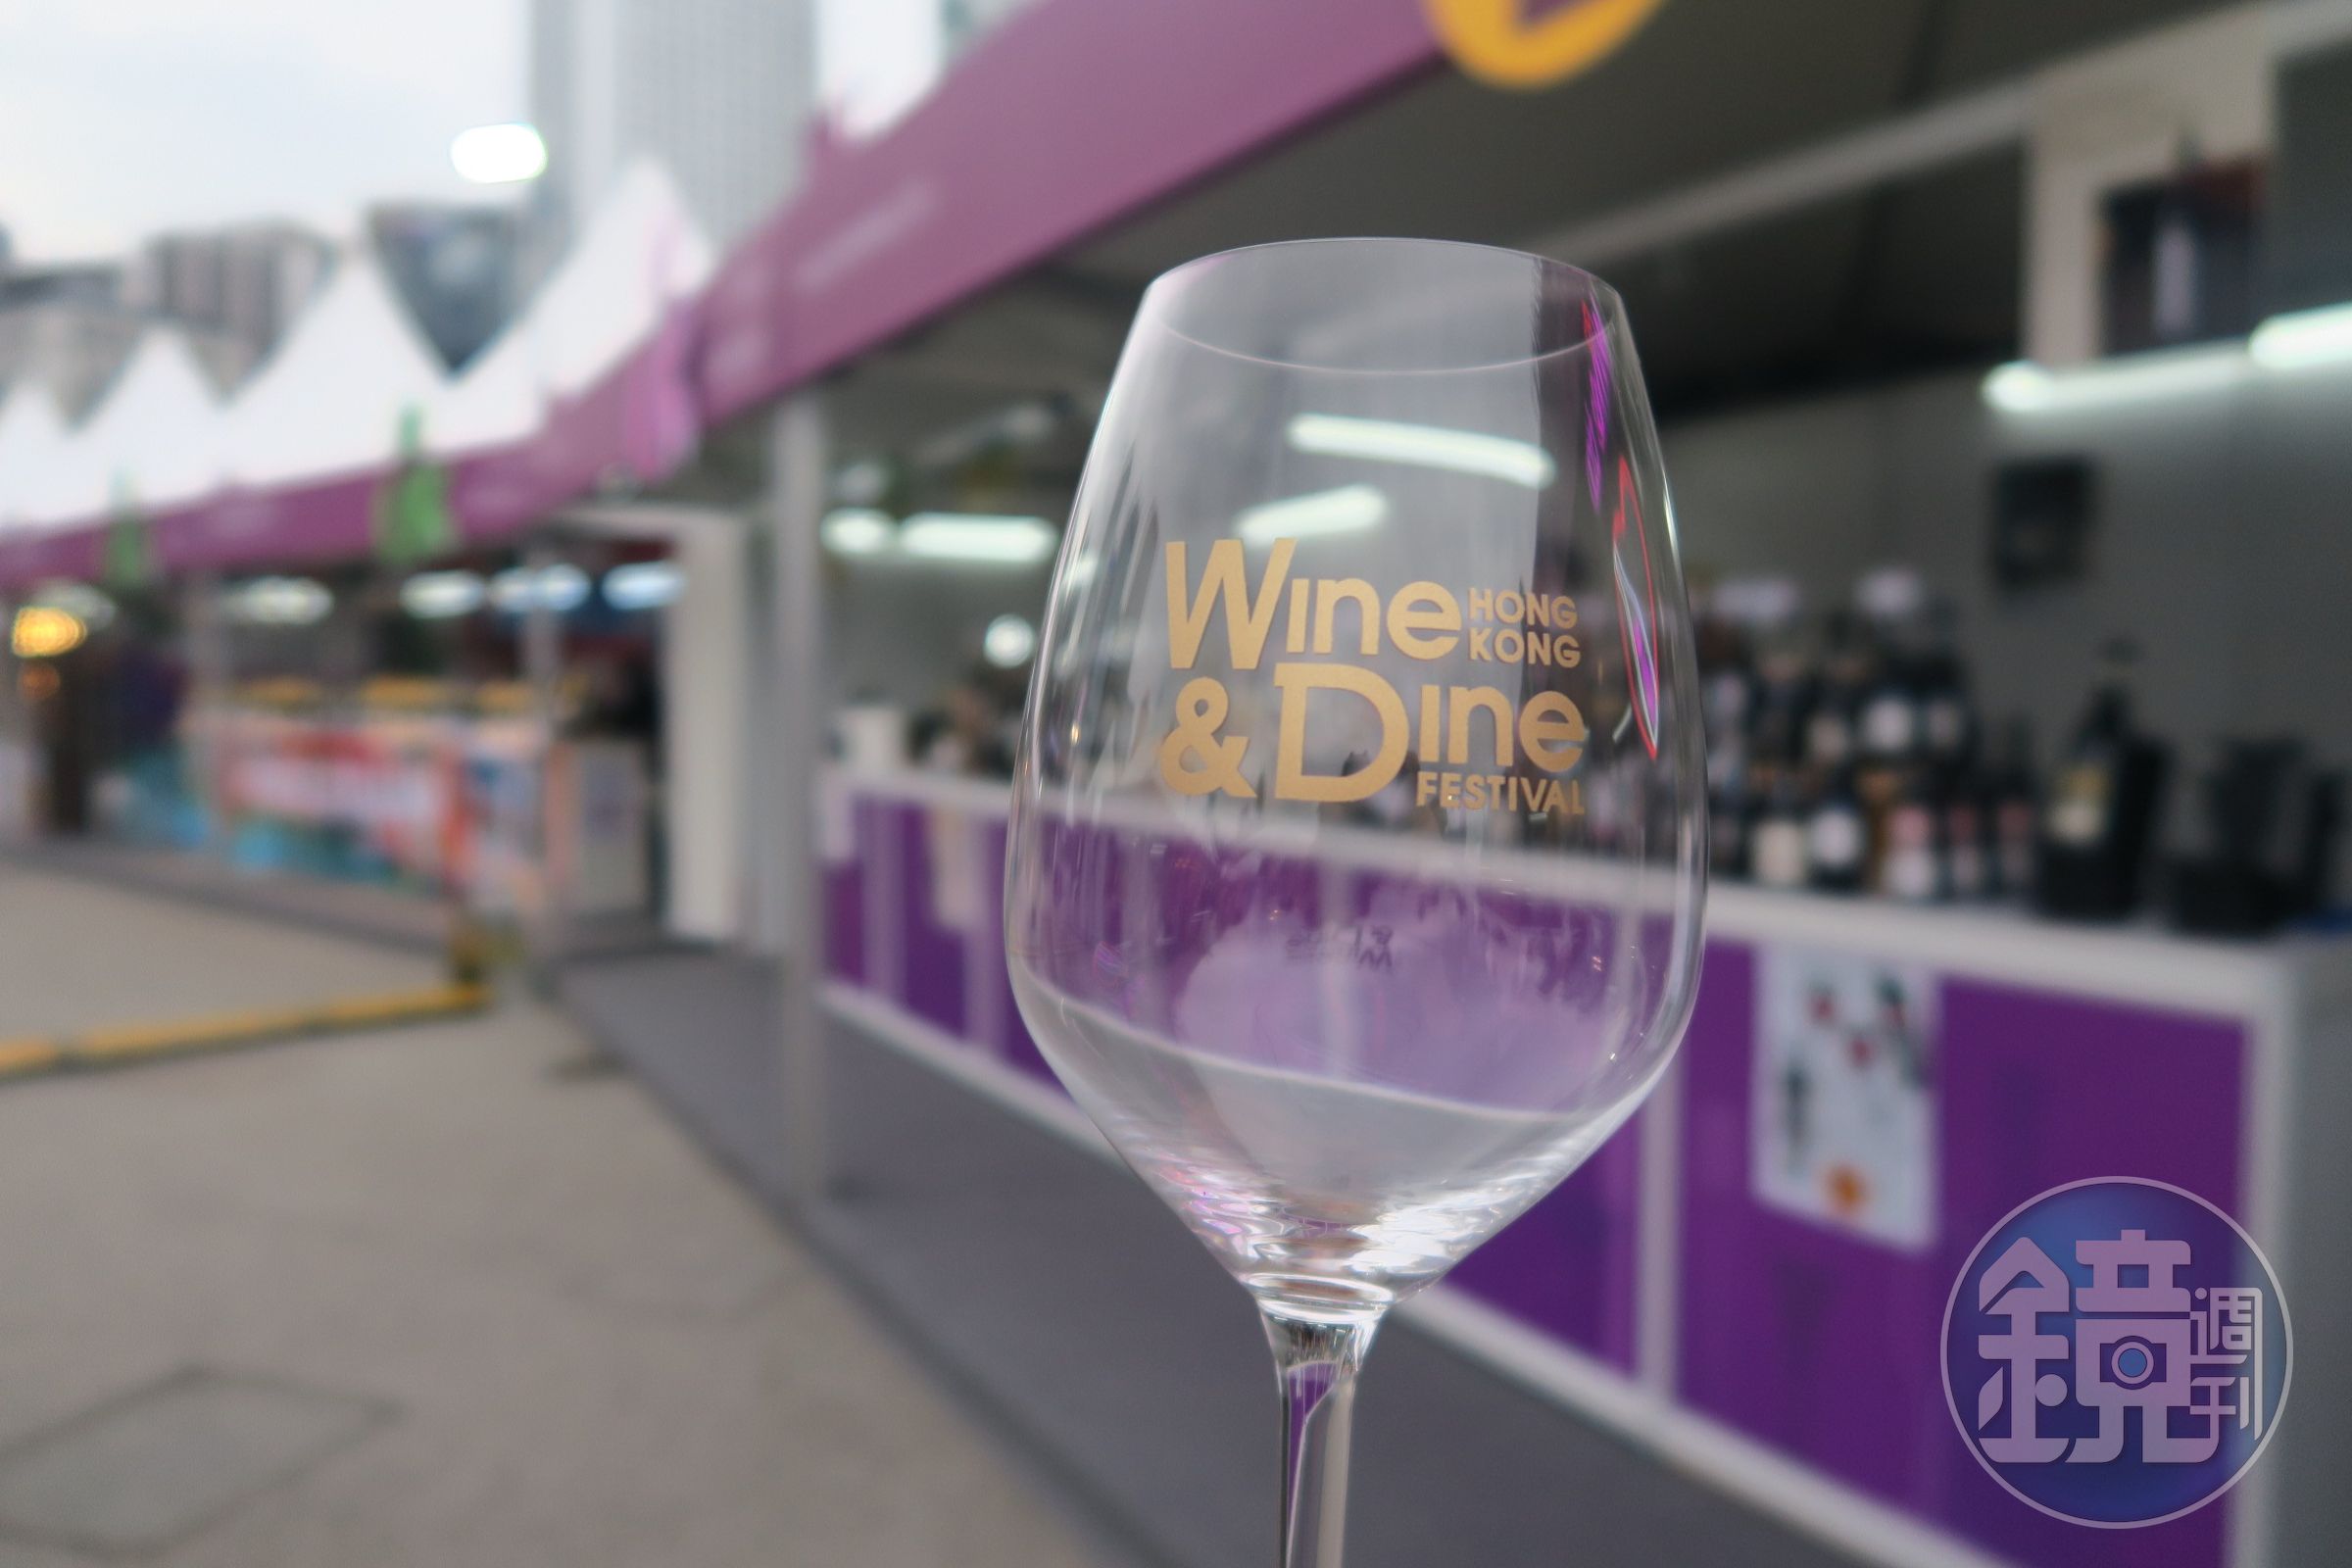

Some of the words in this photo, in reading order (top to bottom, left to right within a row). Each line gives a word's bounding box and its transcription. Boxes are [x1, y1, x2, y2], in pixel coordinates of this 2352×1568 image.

[1165, 538, 1461, 669] Wine
[1470, 588, 1578, 629] HONG
[1470, 630, 1582, 668] KONG
[1160, 677, 1257, 798] &
[1275, 662, 1585, 803] Dine
[1416, 771, 1585, 815] FESTIVAL
